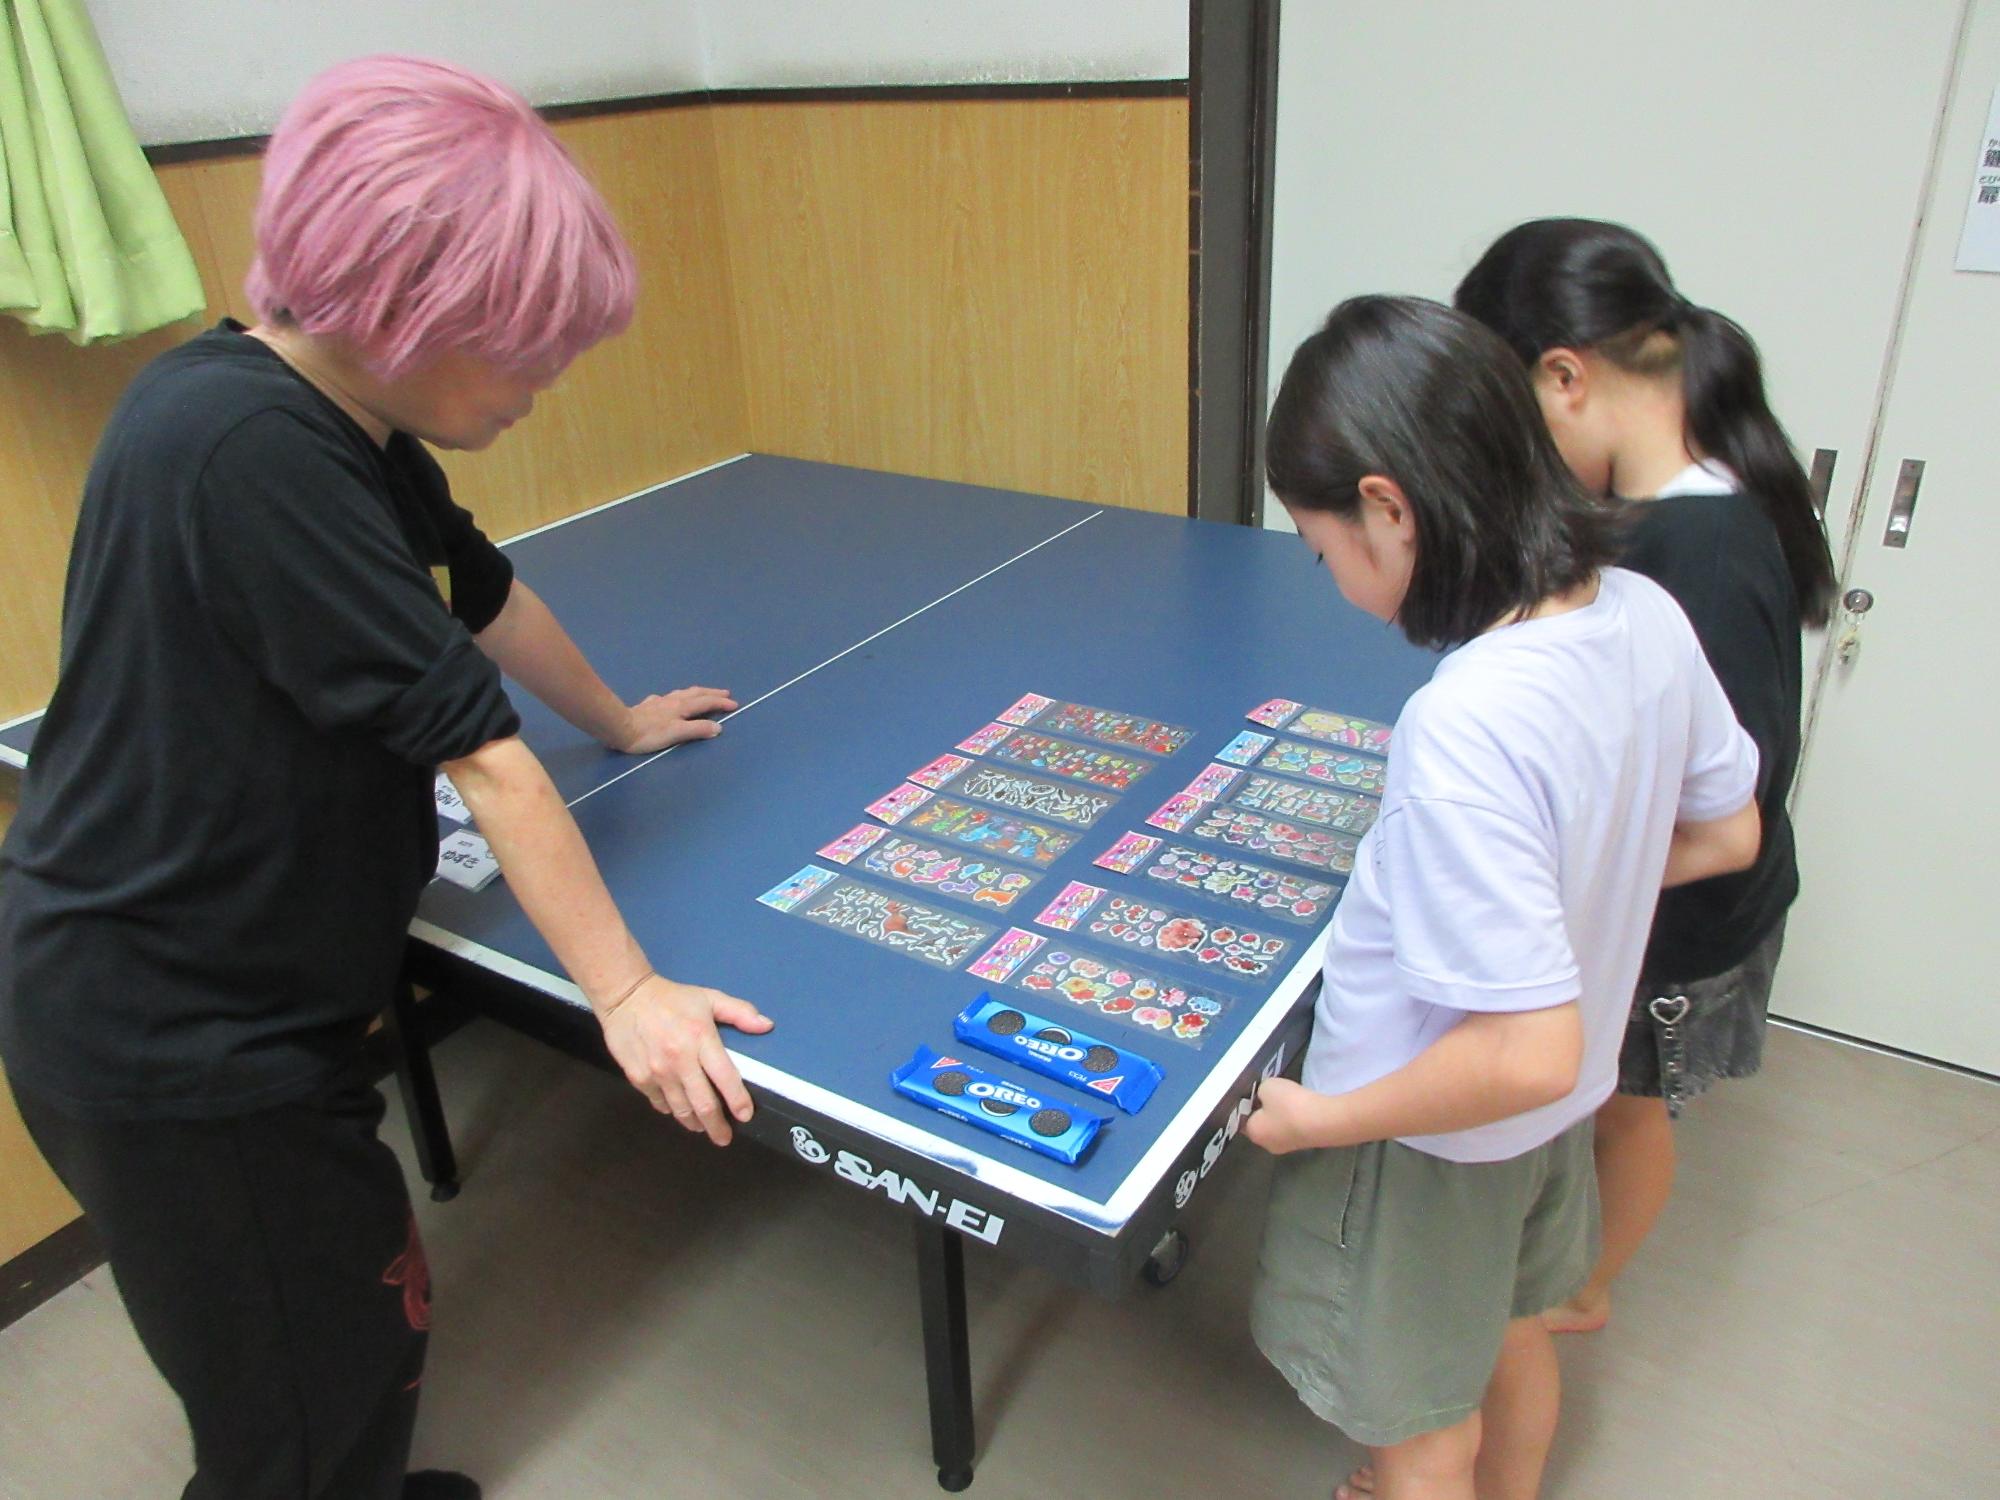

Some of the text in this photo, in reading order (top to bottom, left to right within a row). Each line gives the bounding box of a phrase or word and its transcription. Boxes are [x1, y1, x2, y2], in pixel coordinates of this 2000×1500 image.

[1014, 1035, 1085, 1061] OREO
[967, 1082, 1041, 1109] OREO
[833, 1149, 1005, 1246] SAN-EI
